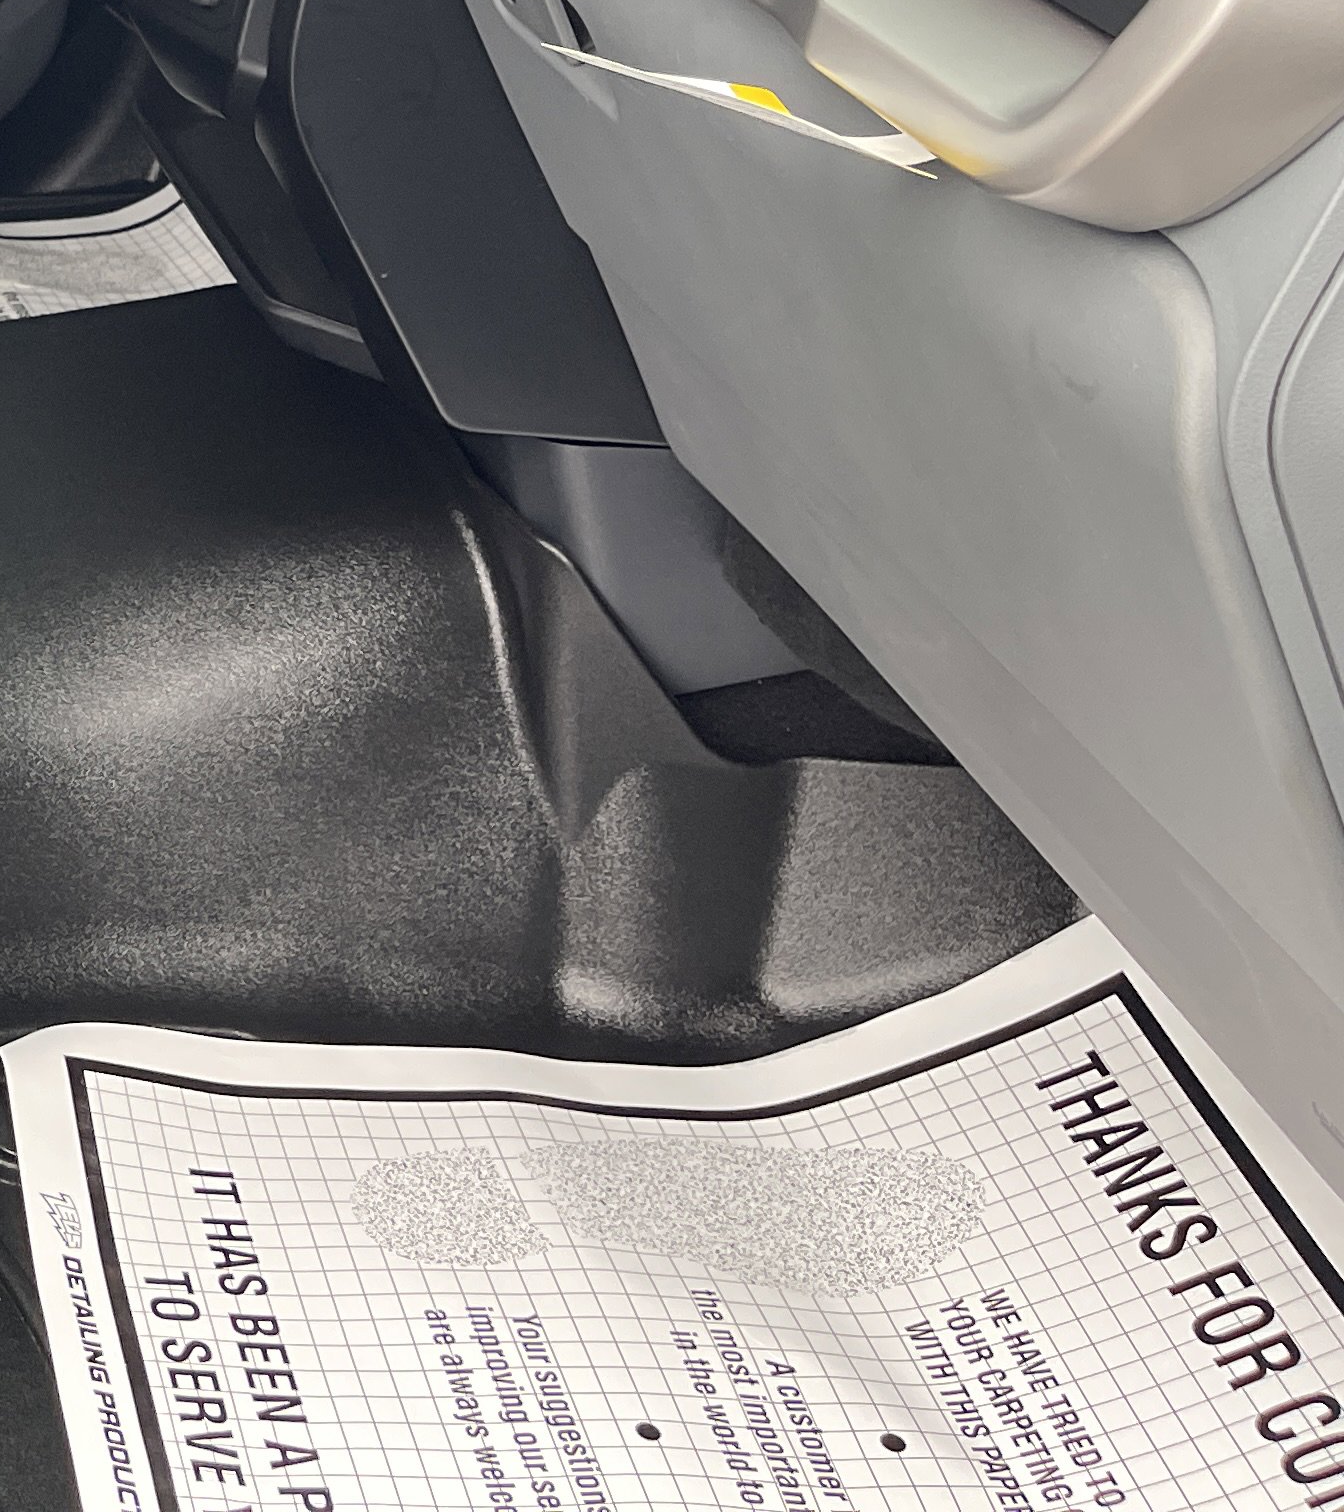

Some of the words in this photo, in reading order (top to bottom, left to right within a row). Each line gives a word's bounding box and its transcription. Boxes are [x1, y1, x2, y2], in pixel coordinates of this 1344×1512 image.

[188, 1168, 242, 1204] IT
[1035, 1049, 1218, 1261] THANKS
[1167, 1261, 1301, 1391] FOR
[143, 1271, 201, 1322] TO
[201, 1217, 269, 1296] HAS
[61, 1254, 112, 1385] DETAILING
[423, 1308, 456, 1345] are
[512, 1313, 552, 1364] Your
[670, 1330, 698, 1350] in
[690, 1289, 723, 1321] the
[710, 1328, 759, 1386] most
[228, 1312, 309, 1423] BEEN
[439, 1353, 490, 1439] always
[465, 1305, 530, 1424] improving
[513, 1431, 548, 1473] our
[683, 1357, 717, 1395] the
[765, 1359, 796, 1377] A
[904, 1319, 959, 1379] WITH
[939, 1383, 990, 1438] THIS
[939, 1297, 994, 1364] YOUR
[977, 1368, 1073, 1503] CARPETING
[979, 1288, 1022, 1329] WE
[1002, 1330, 1060, 1393] HAVE
[1041, 1393, 1103, 1468] TRIED
[1084, 1471, 1126, 1507] TO
[161, 1338, 247, 1487] SERVE
[703, 1403, 759, 1473] world
[777, 1384, 848, 1502] customer
[263, 1438, 320, 1470] A
[736, 1479, 765, 1505] to
